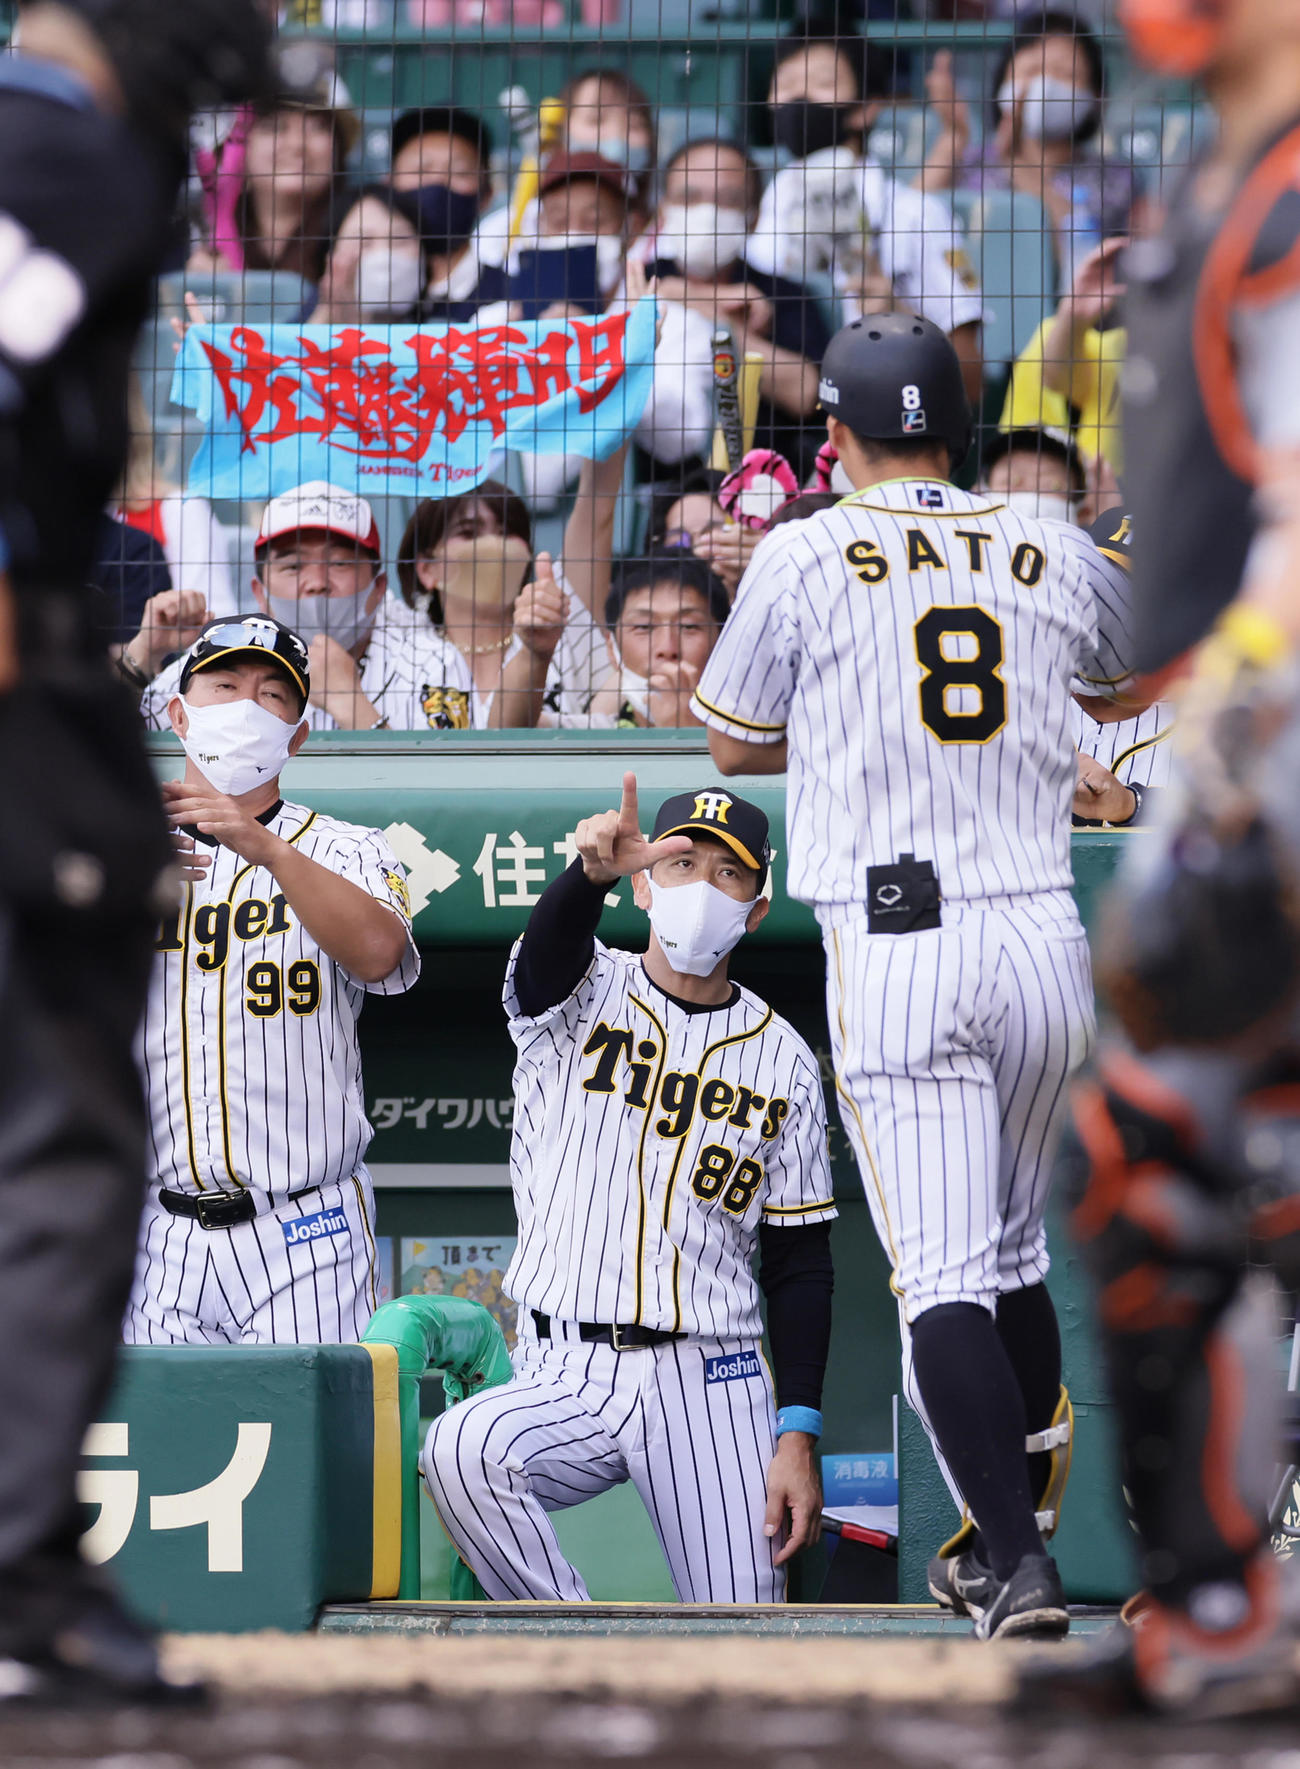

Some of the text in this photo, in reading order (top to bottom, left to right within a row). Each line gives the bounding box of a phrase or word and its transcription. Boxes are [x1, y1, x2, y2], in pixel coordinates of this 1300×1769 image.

[901, 384, 921, 410] 8
[845, 529, 1047, 588] SATO
[913, 604, 1009, 745] 8
[198, 753, 220, 764] Tigers
[155, 893, 292, 972] iger
[246, 959, 322, 1018] 99
[582, 1021, 789, 1141] Tigers
[691, 1143, 765, 1215] 88
[286, 1212, 347, 1243] Joshin
[707, 1354, 760, 1381] Joshin
[833, 1459, 889, 1480] 消毒液
